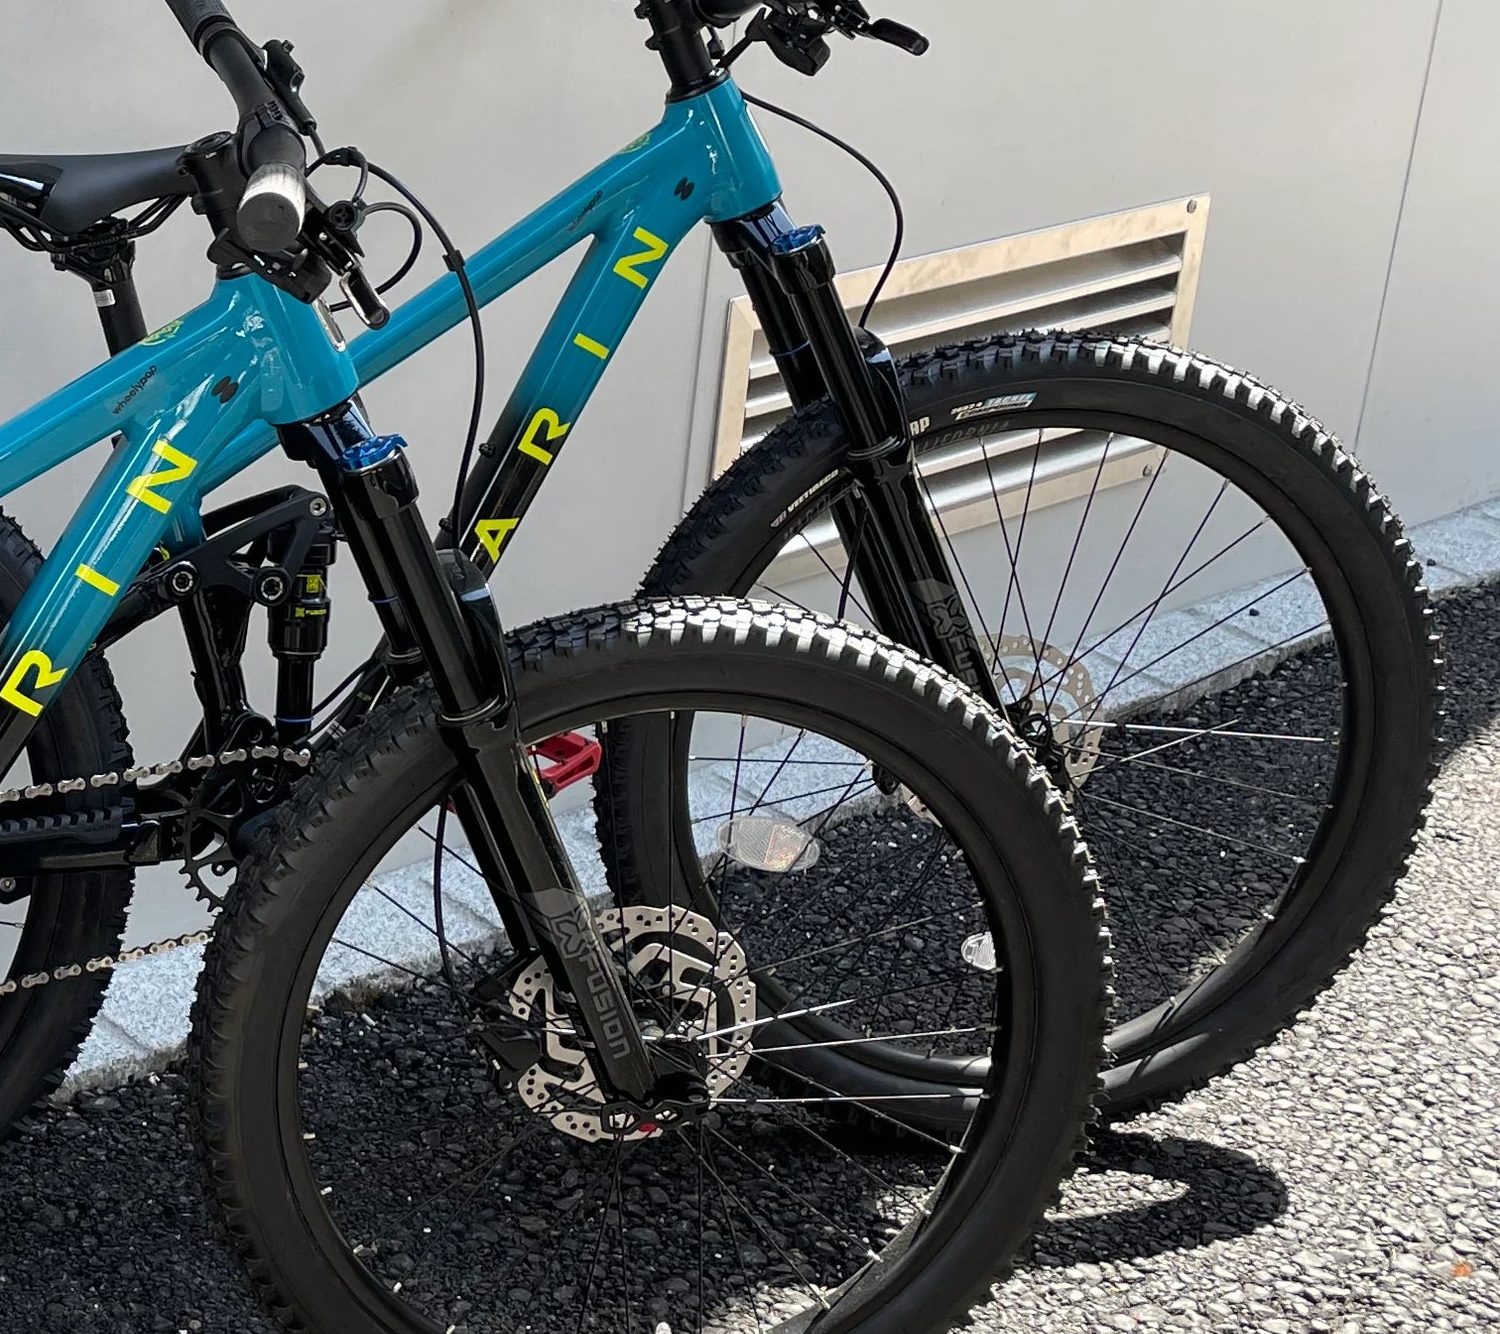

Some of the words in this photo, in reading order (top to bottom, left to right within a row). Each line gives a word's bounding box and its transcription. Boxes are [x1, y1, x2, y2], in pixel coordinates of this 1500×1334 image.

[112, 365, 157, 415] wheelypop
[475, 226, 669, 564] ARIN
[580, 952, 632, 1059] FUSION
